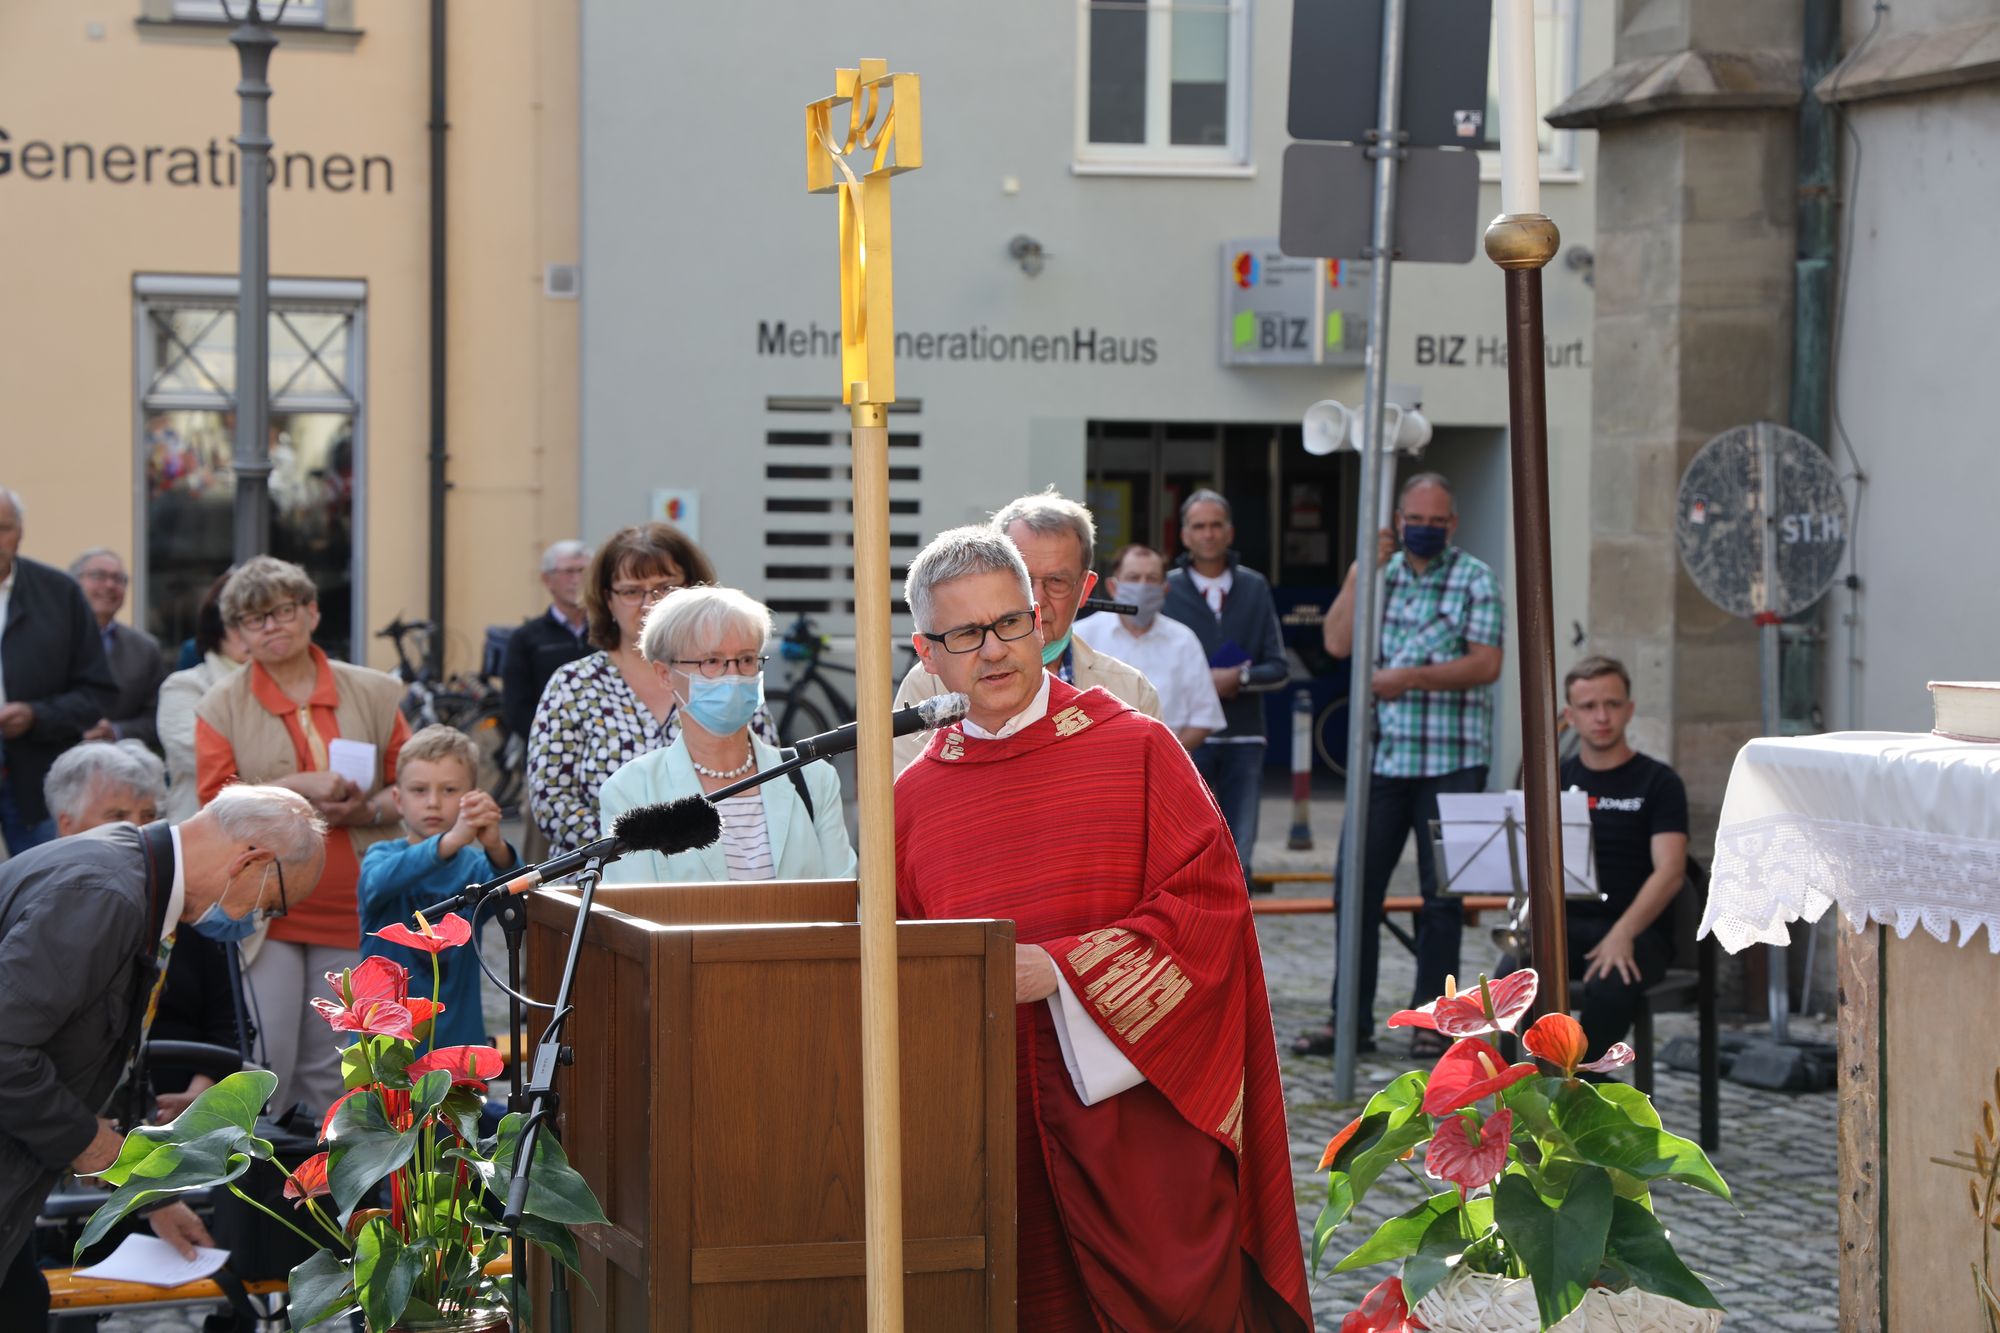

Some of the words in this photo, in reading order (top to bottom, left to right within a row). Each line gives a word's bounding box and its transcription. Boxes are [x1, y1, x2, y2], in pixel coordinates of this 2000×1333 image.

[757, 319, 1158, 365] MehrnerationenHaus
[1261, 318, 1308, 350] BIZ
[1415, 335, 1466, 366] BIZ
